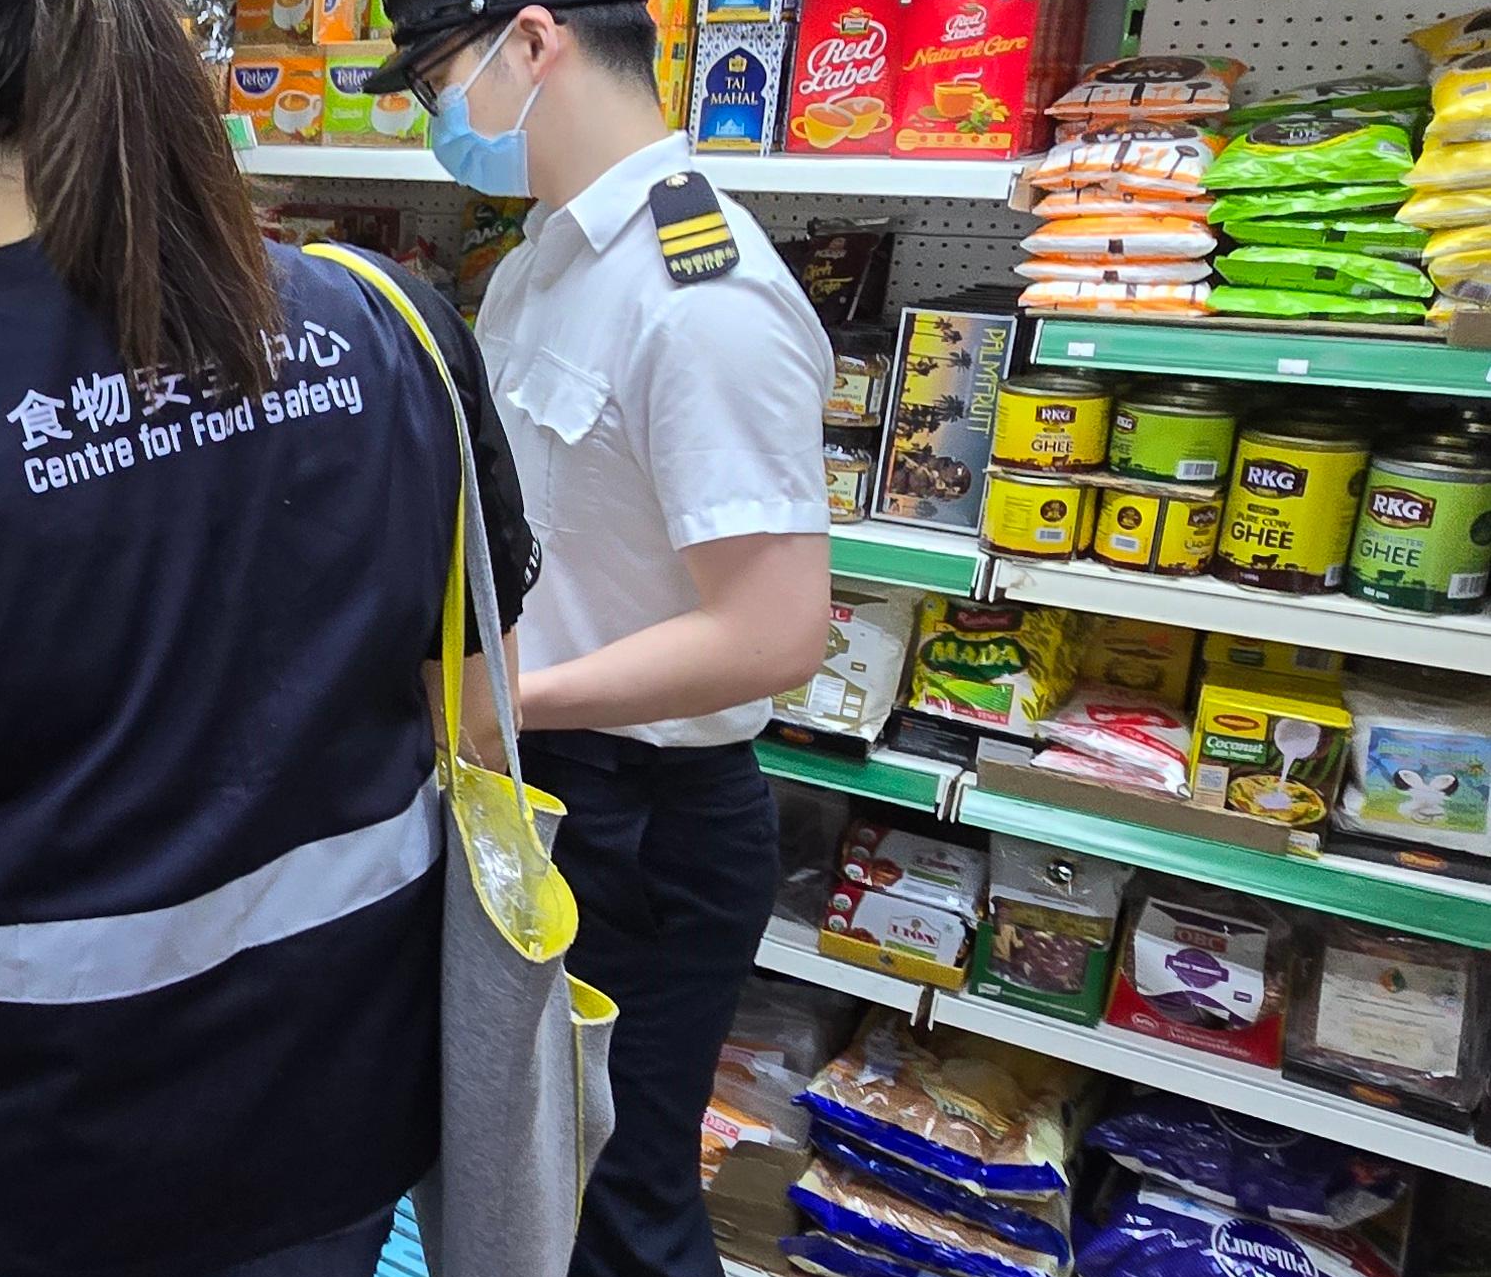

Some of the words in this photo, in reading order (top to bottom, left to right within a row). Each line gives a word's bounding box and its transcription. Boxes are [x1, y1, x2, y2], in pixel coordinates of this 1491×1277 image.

[945, 7, 988, 34] Red
[807, 20, 888, 73] Red
[903, 43, 983, 71] Natural
[983, 36, 1028, 57] Care
[724, 76, 746, 92] TAJ
[799, 59, 886, 94] Label
[709, 90, 758, 106] MAHAL
[1040, 406, 1074, 423] RKG
[23, 436, 135, 494] Centre
[138, 421, 182, 460] for
[190, 395, 255, 447] Food
[261, 375, 364, 424] Safety
[1030, 438, 1075, 455] GHEE
[1245, 466, 1297, 492] RKG
[1370, 492, 1424, 521] RKG
[1230, 520, 1296, 551] GHEE
[1359, 539, 1422, 568] GHEE
[1205, 734, 1265, 756] Coconut
[1176, 929, 1225, 951] OBC
[1219, 1231, 1313, 1277] Pillsbury
